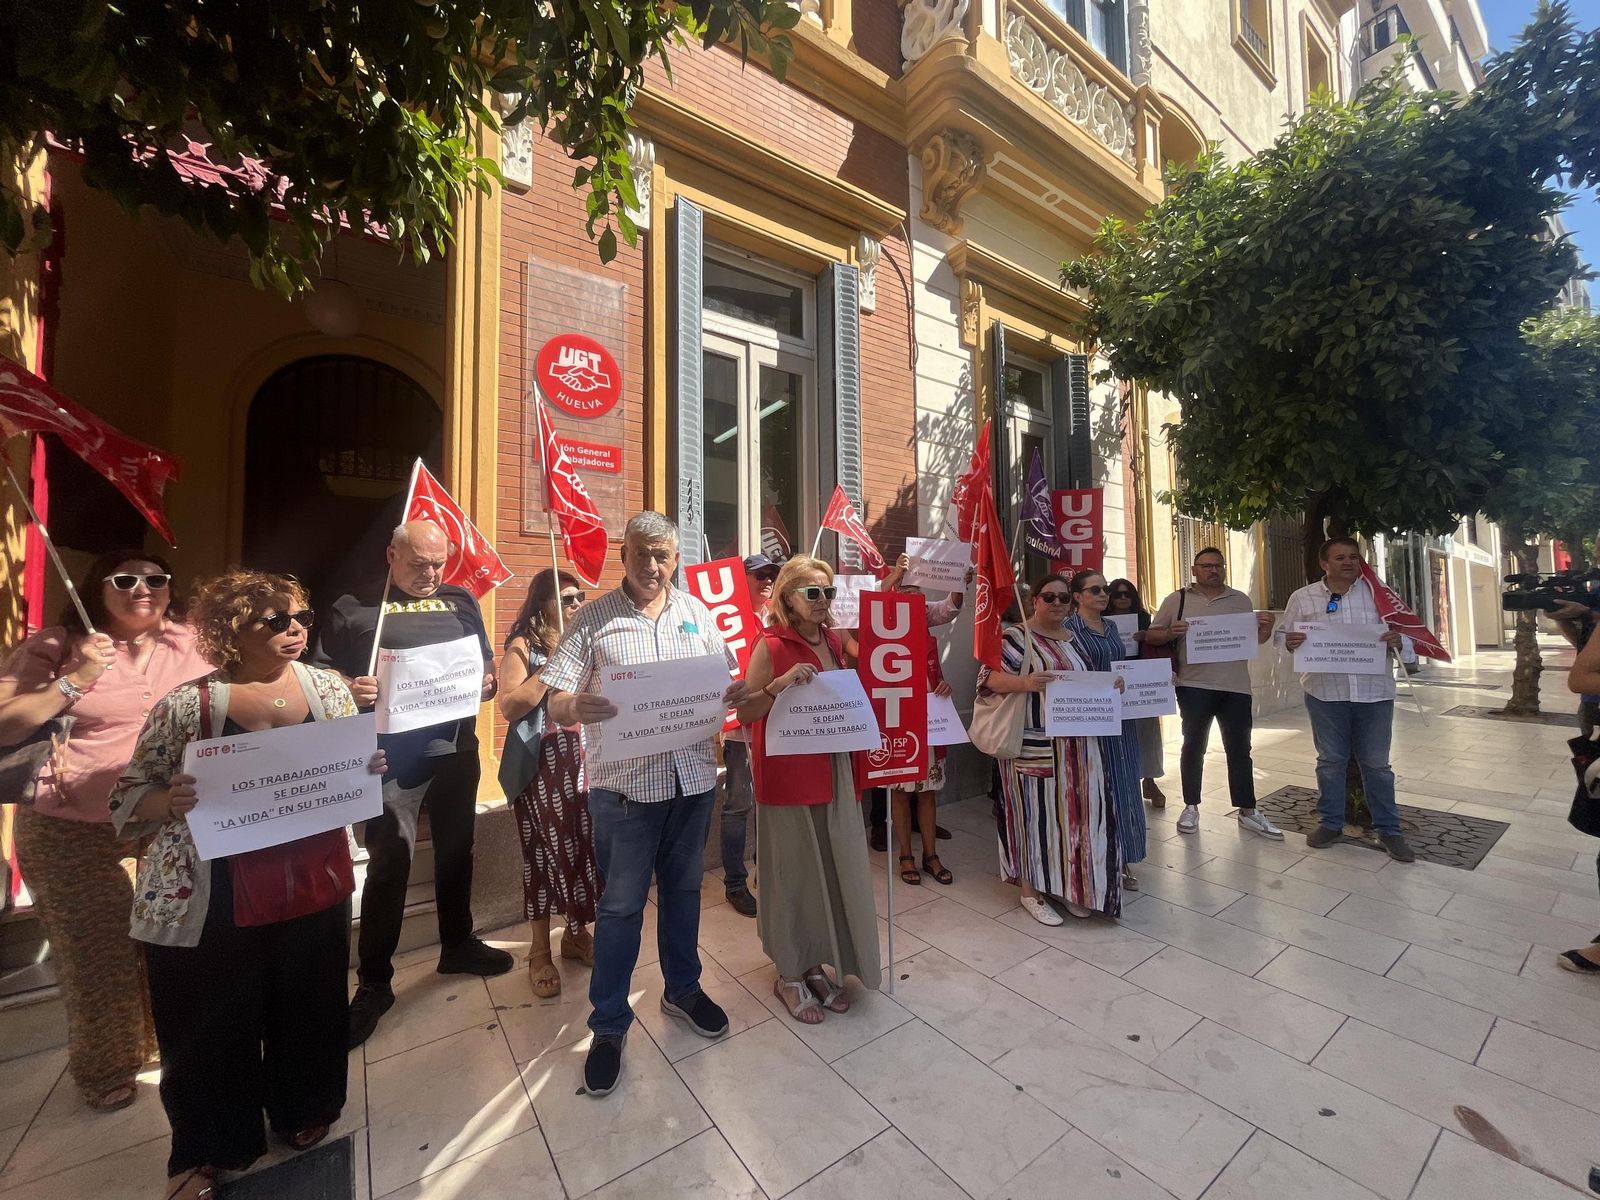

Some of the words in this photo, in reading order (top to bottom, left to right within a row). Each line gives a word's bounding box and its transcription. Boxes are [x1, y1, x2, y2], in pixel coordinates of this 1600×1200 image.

[558, 346, 602, 373] UGT
[557, 391, 604, 410] HUELVA
[577, 446, 611, 458] General
[1060, 494, 1093, 566] UGT
[869, 600, 913, 729] UGT
[396, 681, 413, 691] LOS
[414, 667, 476, 688] TRABAJADORES/AS
[610, 672, 626, 681] UGT
[423, 689, 432, 697] SE
[433, 684, 457, 695] DEJAN
[425, 700, 436, 708] EN
[437, 697, 449, 705] SU
[449, 689, 479, 703] TRABAJO
[633, 702, 649, 712] LOS
[650, 691, 721, 708] TRABAJADORES/AS
[789, 705, 803, 713] LOS
[804, 700, 864, 713] TRABAJADORES/AS
[659, 712, 668, 720] SE
[670, 708, 695, 718] DEJAN
[822, 714, 846, 722] DEJAN
[618, 730, 633, 740] "LA
[635, 726, 659, 737] VIDA"
[660, 725, 672, 733] EN
[673, 722, 683, 731] SU
[779, 729, 793, 737] "LA
[793, 728, 814, 736] VIDA"
[838, 723, 868, 734] TRABAJO
[893, 737, 908, 748] FSP
[196, 746, 220, 758] UGT
[231, 779, 256, 793] LOS
[258, 757, 364, 784] TRABAJADORES/AS
[273, 789, 287, 799] SE
[290, 780, 327, 797] DEJAN
[213, 818, 236, 830] "LA
[238, 808, 275, 825] VIDA"
[278, 804, 294, 816] EN
[297, 800, 313, 811] SU
[316, 788, 363, 807] TRABAJO
